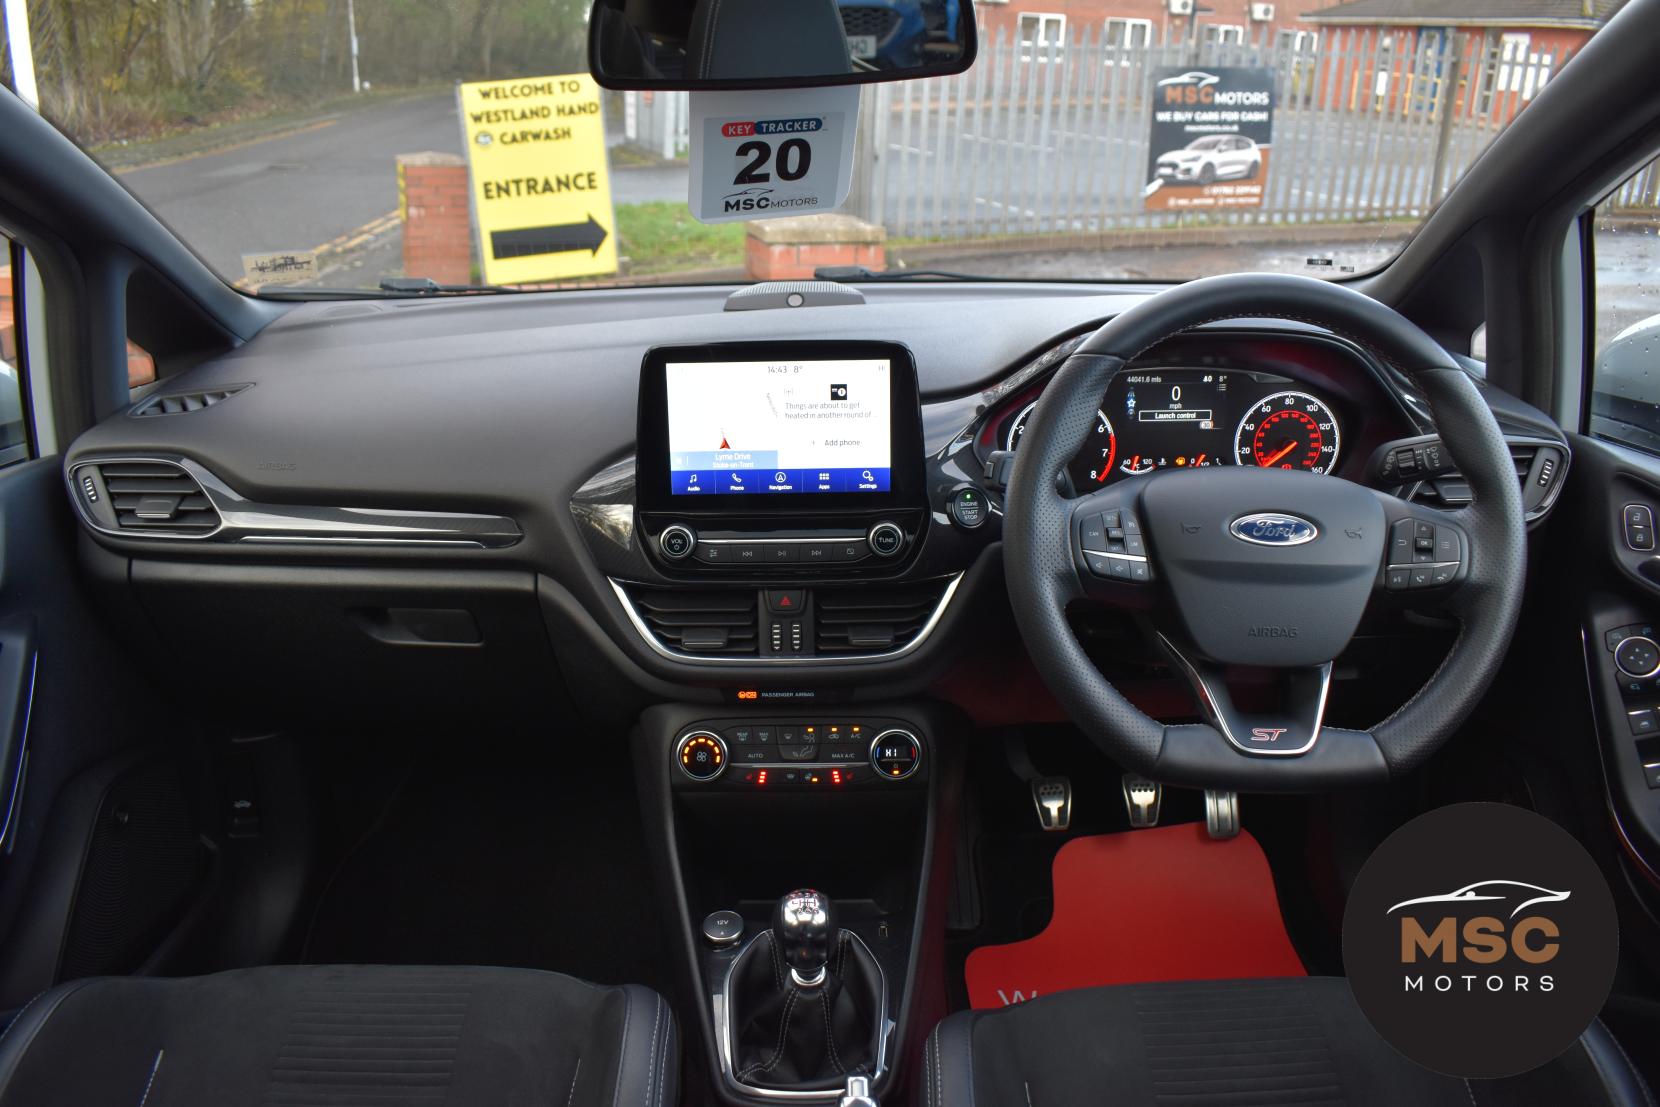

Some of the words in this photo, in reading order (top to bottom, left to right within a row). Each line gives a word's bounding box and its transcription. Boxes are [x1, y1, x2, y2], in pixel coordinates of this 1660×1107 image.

[478, 82, 554, 100] WELCOME
[559, 80, 581, 93] TO
[1165, 85, 1214, 105] MSC
[1214, 91, 1270, 106] MOTORS
[470, 104, 551, 125] WESTLAND
[556, 102, 600, 118] HAND
[1156, 111, 1172, 121] WE
[728, 124, 752, 136] KEY
[761, 120, 817, 133] TRACKER
[500, 127, 572, 146] CARWASH
[733, 137, 812, 186] 20
[483, 171, 598, 201] ENTRANCE
[724, 196, 771, 213] MSC
[771, 196, 819, 209] MOTORS
[767, 365, 788, 374] 14:43
[1171, 385, 1181, 401] 0
[785, 402, 807, 410] Things
[820, 402, 839, 410] about
[785, 411, 809, 420] heated
[817, 411, 843, 419] another
[1154, 412, 1176, 420] Launch
[1176, 411, 1197, 419] control
[1018, 425, 1025, 435] 2
[1097, 425, 1105, 433] 6
[1245, 423, 1255, 431] 40
[824, 439, 839, 447] Add
[839, 439, 861, 448] phone
[1102, 448, 1109, 457] 7
[1090, 470, 1097, 479] 8
[1311, 466, 1323, 474] 160
[1252, 519, 1297, 538] Ford
[1246, 625, 1299, 640] AIRBAG
[1250, 726, 1288, 742] ST
